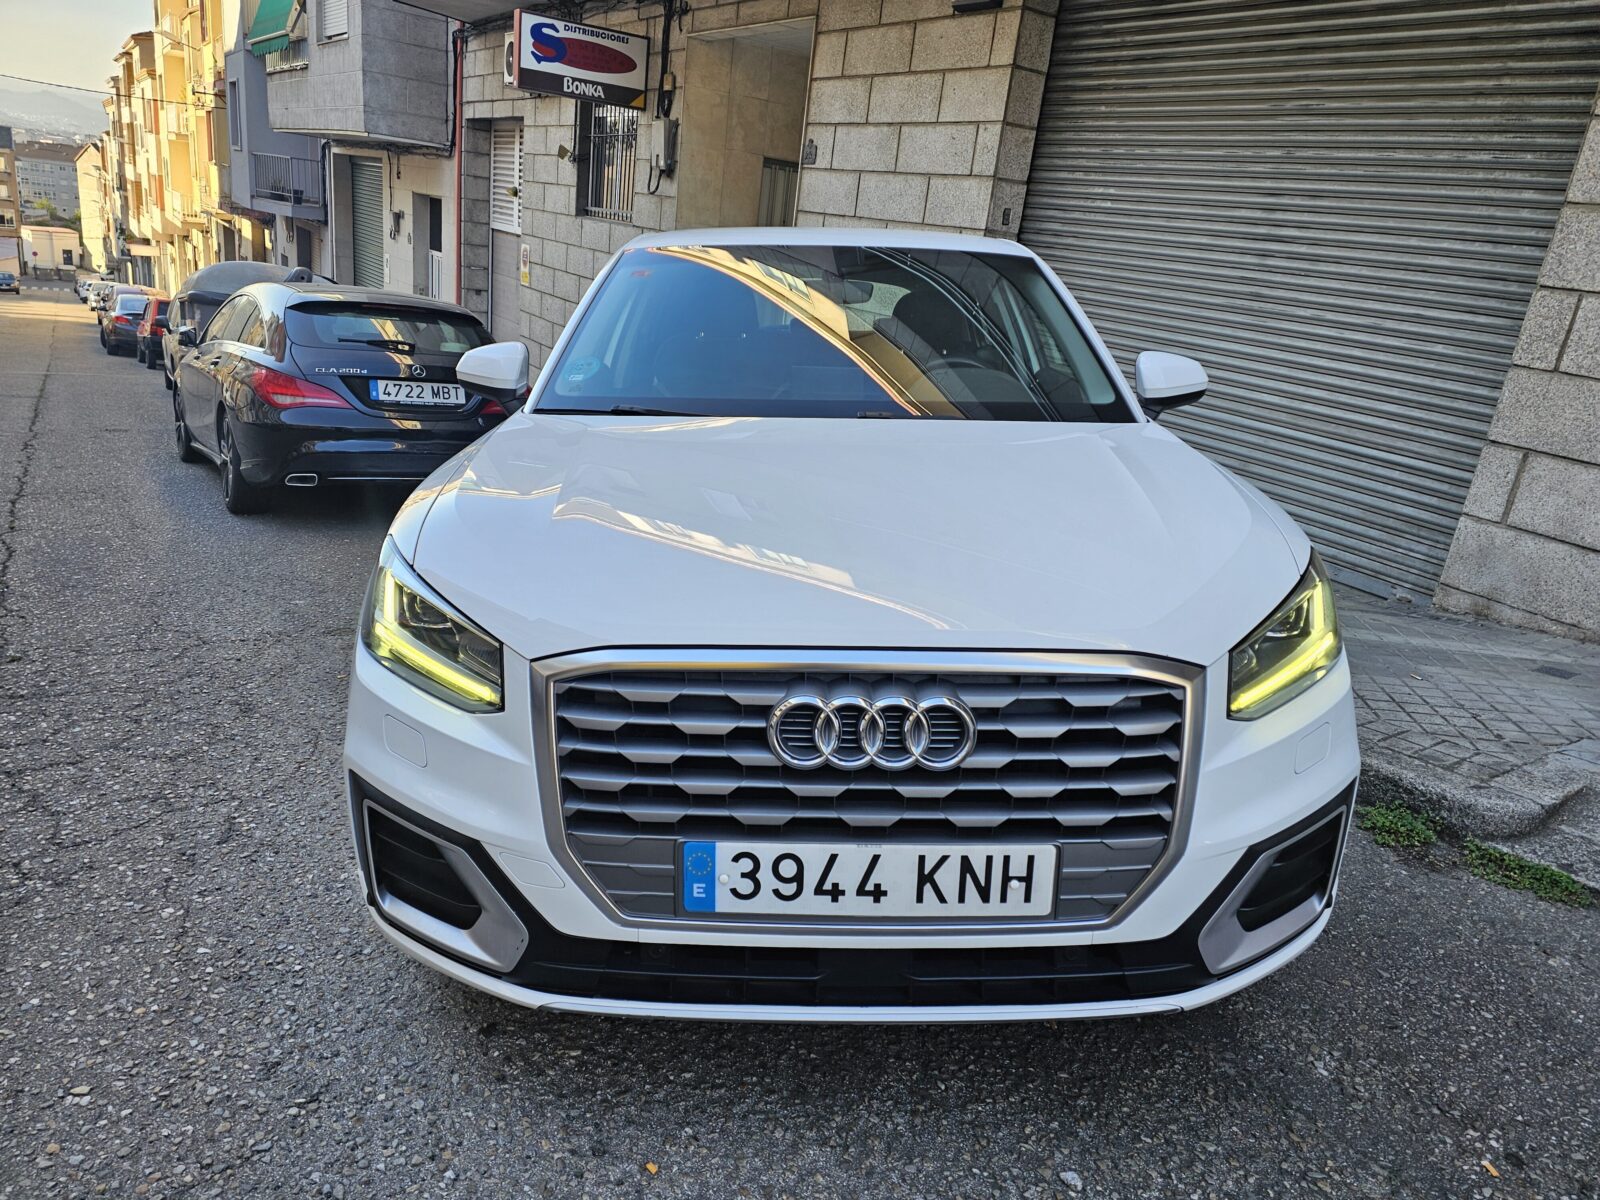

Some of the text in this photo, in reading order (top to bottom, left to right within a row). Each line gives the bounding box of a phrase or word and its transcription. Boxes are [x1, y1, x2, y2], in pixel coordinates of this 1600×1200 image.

[563, 24, 630, 45] DISTRIBUCIONES
[563, 76, 605, 99] BONKA
[382, 383, 461, 401] 4722 MBT
[728, 851, 1036, 905] 3944 KNH
[693, 883, 706, 898] E
